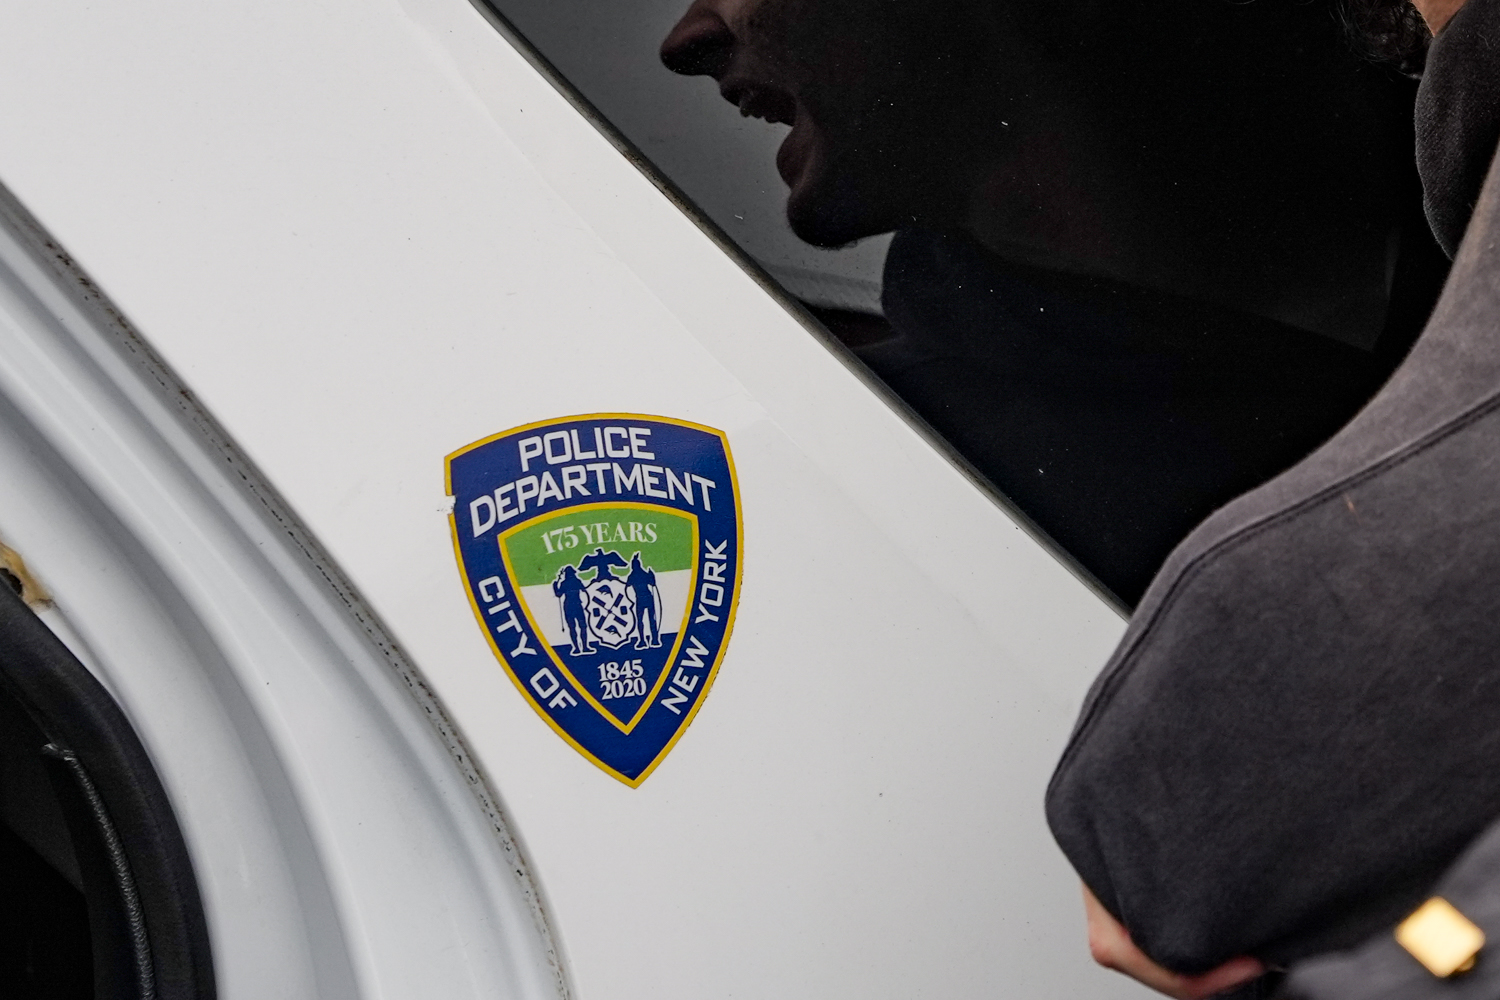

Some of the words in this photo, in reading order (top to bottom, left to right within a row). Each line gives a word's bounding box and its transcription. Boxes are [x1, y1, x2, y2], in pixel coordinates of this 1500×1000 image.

[518, 426, 655, 472] POLICE
[469, 463, 716, 537] DEPARTMENT
[541, 525, 578, 555] 175
[579, 522, 657, 544] YEARS
[478, 575, 537, 659] CITY
[530, 667, 578, 709] OF
[661, 635, 710, 715] NEW
[696, 539, 728, 624] YORK
[597, 659, 645, 682] 1845
[601, 678, 647, 700] 2020
